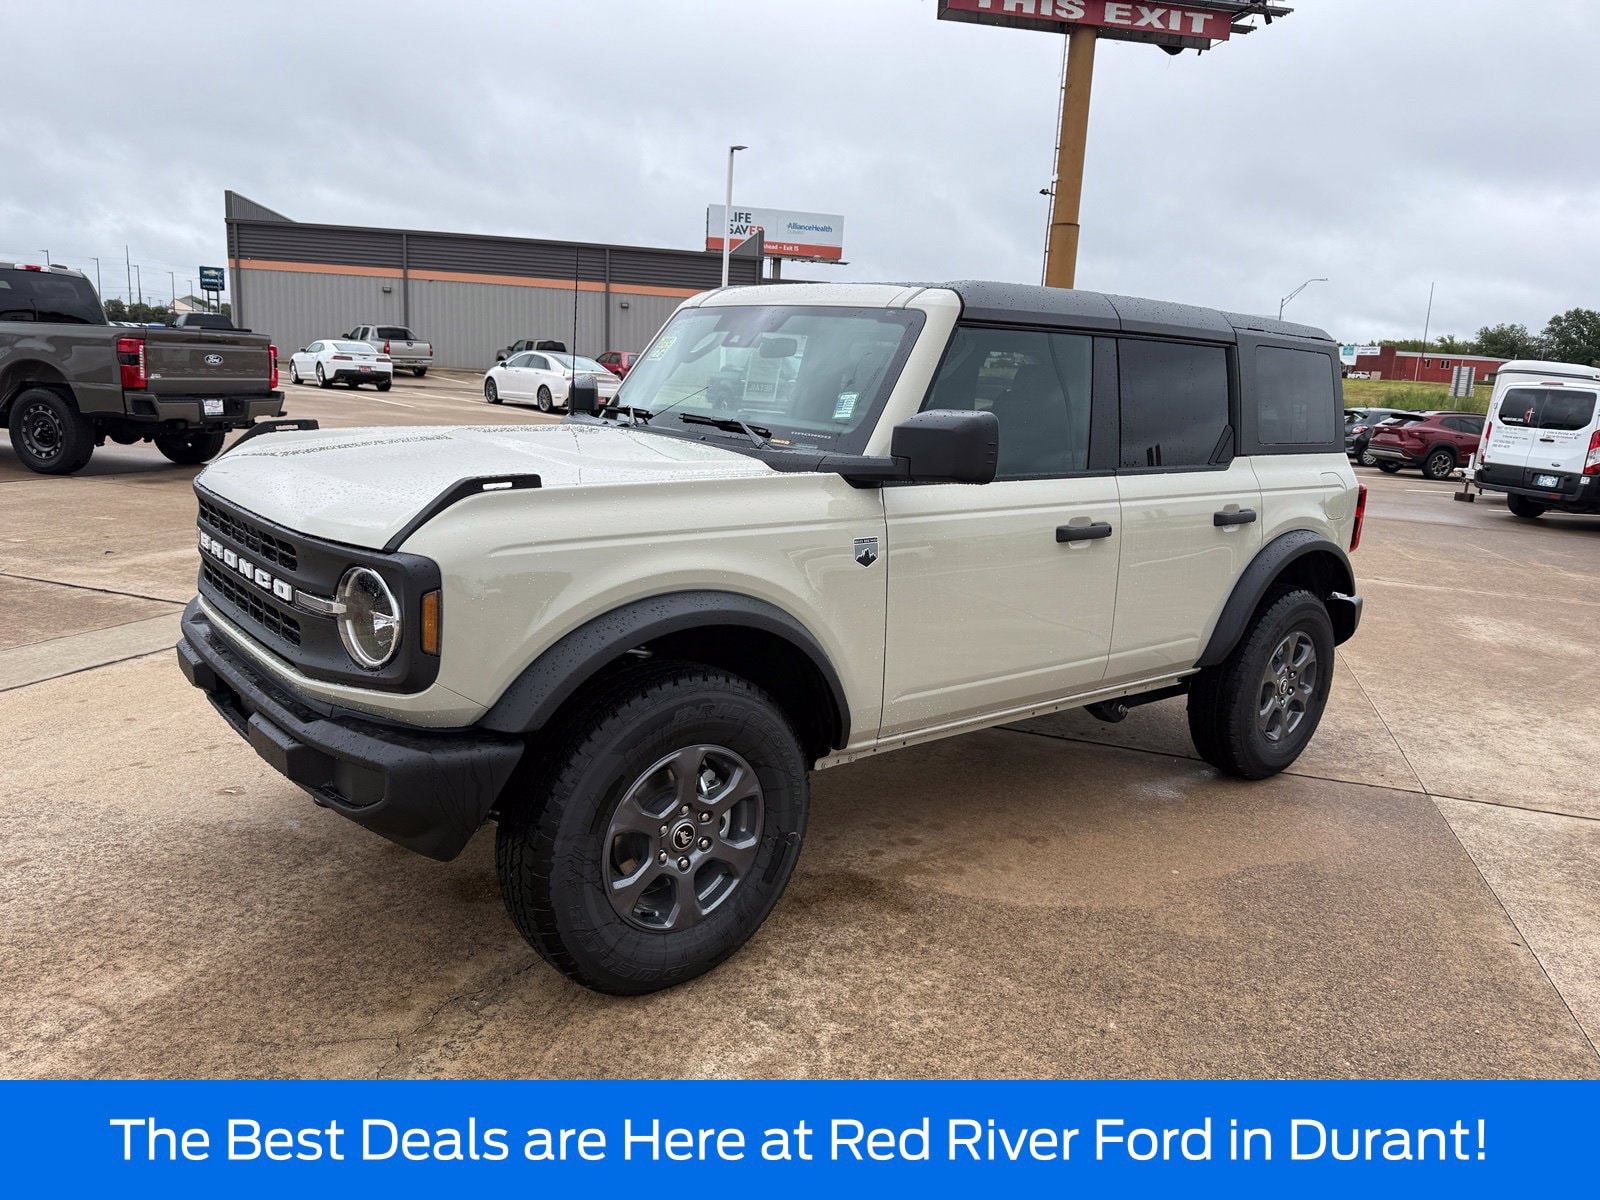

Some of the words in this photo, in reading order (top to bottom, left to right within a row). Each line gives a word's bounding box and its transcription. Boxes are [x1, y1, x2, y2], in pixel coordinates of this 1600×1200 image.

[1103, 2, 1213, 34] EXIT
[730, 212, 752, 223] IFE
[787, 222, 833, 233] AllianceHealth
[200, 530, 292, 601] BRONCO
